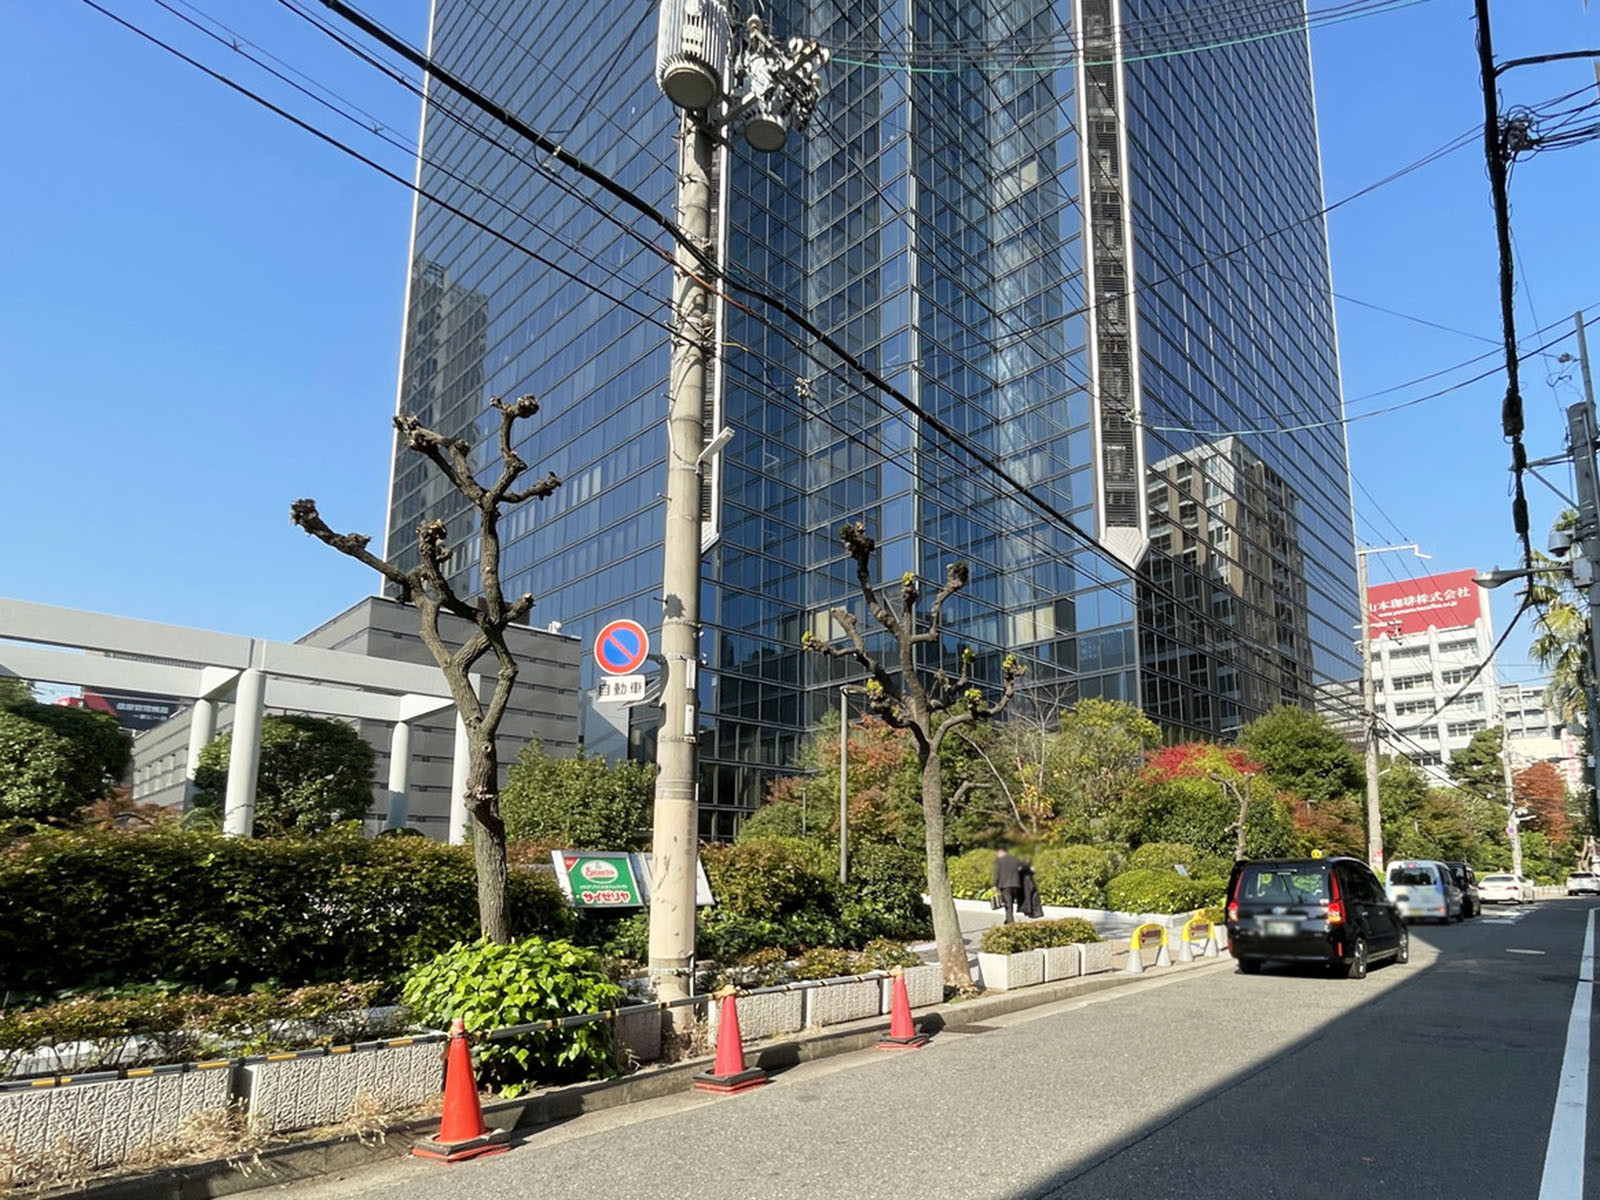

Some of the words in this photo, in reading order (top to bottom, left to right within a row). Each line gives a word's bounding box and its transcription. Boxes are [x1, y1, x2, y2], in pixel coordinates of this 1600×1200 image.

[599, 681, 642, 696] 自動車
[582, 890, 631, 904] サイゼリヤ
